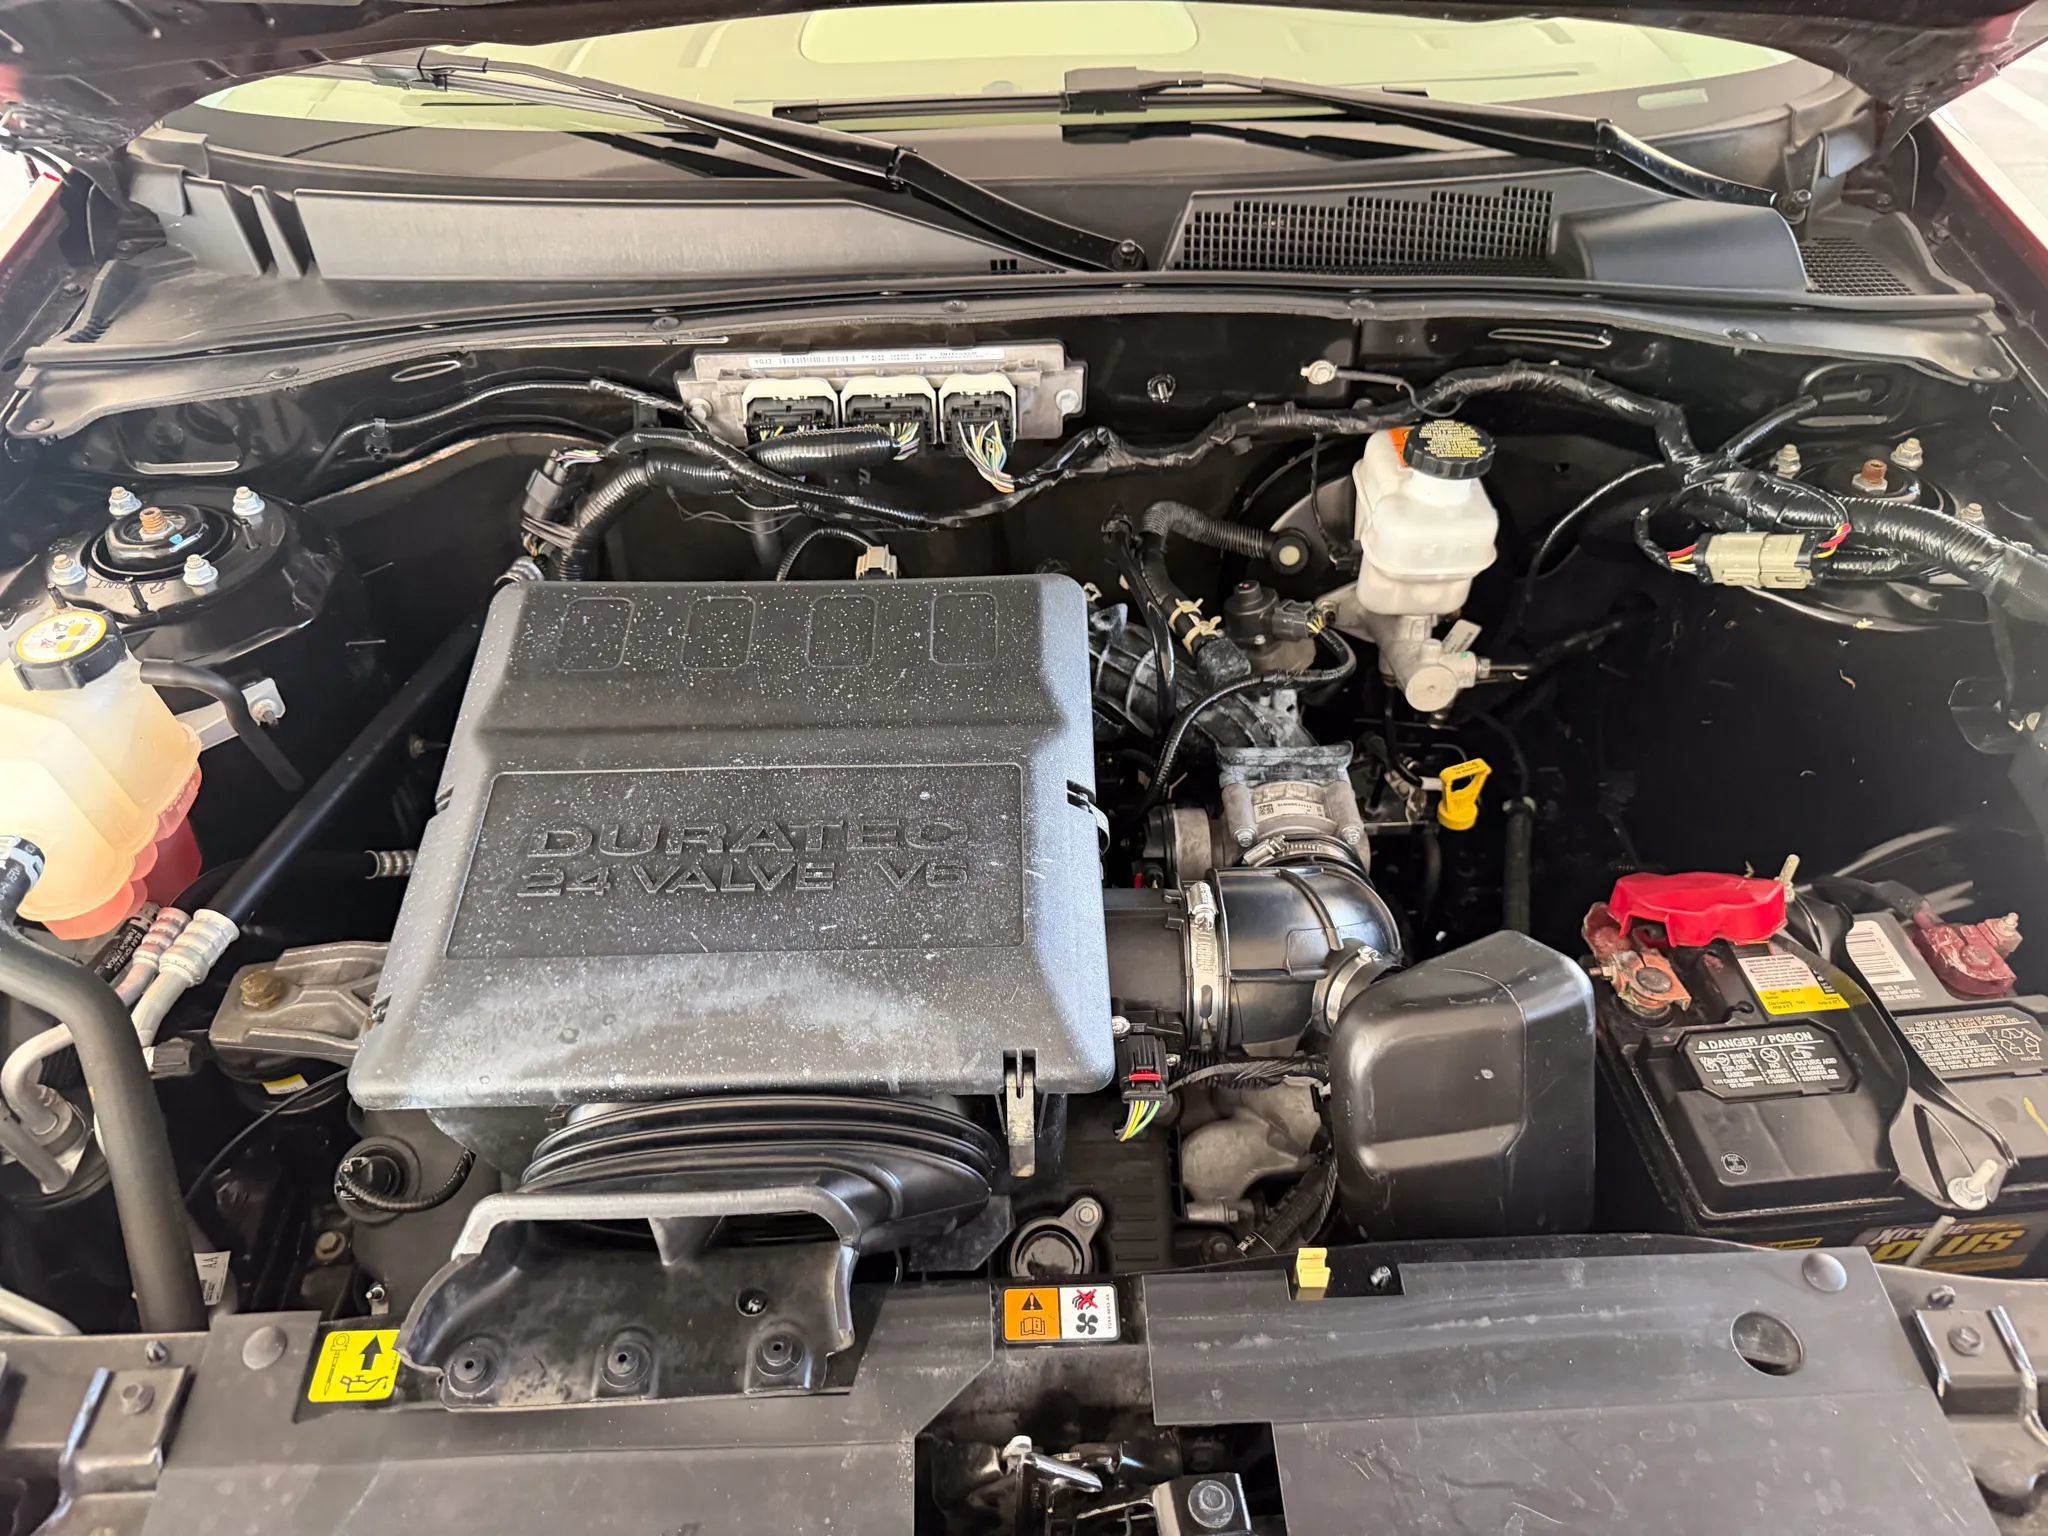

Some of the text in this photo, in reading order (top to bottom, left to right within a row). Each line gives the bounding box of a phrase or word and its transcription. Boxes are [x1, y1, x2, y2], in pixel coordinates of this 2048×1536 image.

[527, 820, 970, 858] DURATEC
[517, 858, 968, 896] 24 VALVE V6
[1707, 1032, 1813, 1050] DANGER / POISON
[1868, 1224, 1971, 1245] Xtree
[1871, 1229, 2026, 1262] PUS
